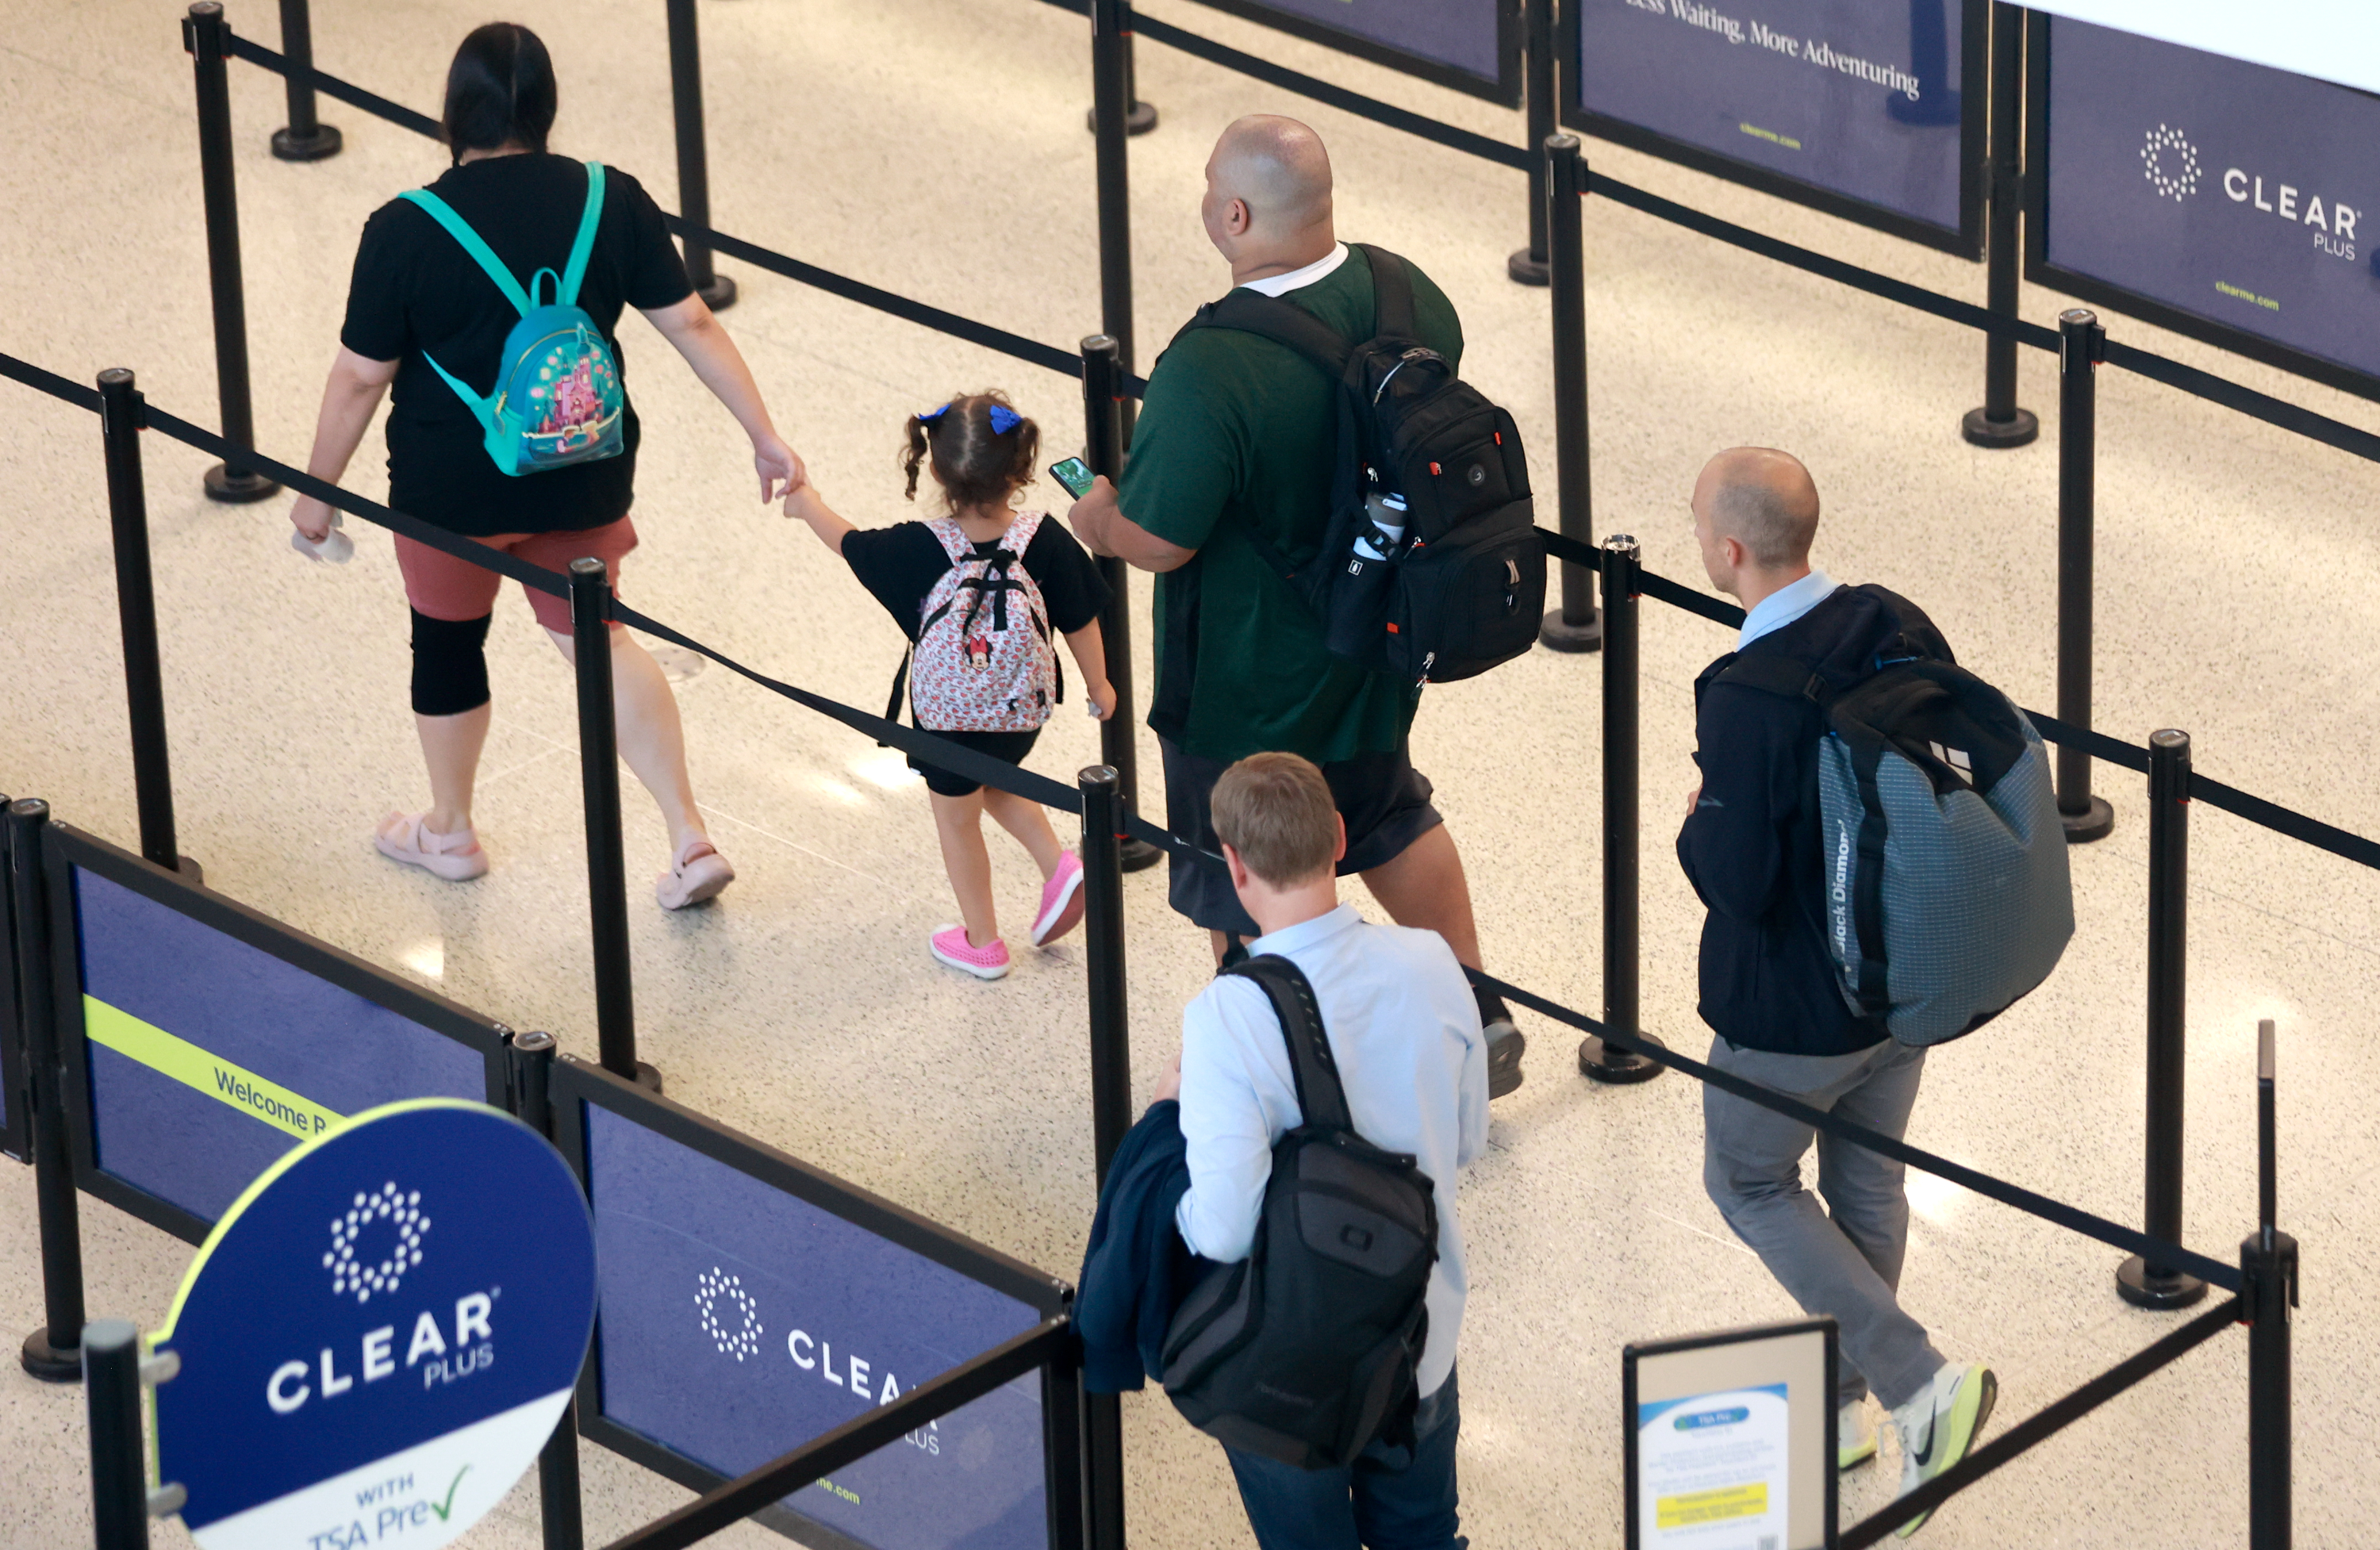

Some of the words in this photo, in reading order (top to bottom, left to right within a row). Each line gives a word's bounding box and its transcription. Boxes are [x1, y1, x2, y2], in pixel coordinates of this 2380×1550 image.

[1626, 0, 1666, 14] ess
[1750, 19, 1798, 57] More
[1802, 39, 1920, 102] Adventuring
[2224, 167, 2356, 241] CLEAR
[2314, 232, 2355, 261] PLUS
[2216, 281, 2279, 311] clearme.com
[214, 1066, 308, 1131] Welcome
[267, 1291, 493, 1414] CLEAR
[424, 1343, 494, 1389] PLUS
[788, 1329, 938, 1431] CLEA
[905, 1429, 939, 1456] LUS
[356, 1472, 414, 1508] WITH
[816, 1478, 859, 1505] me.com
